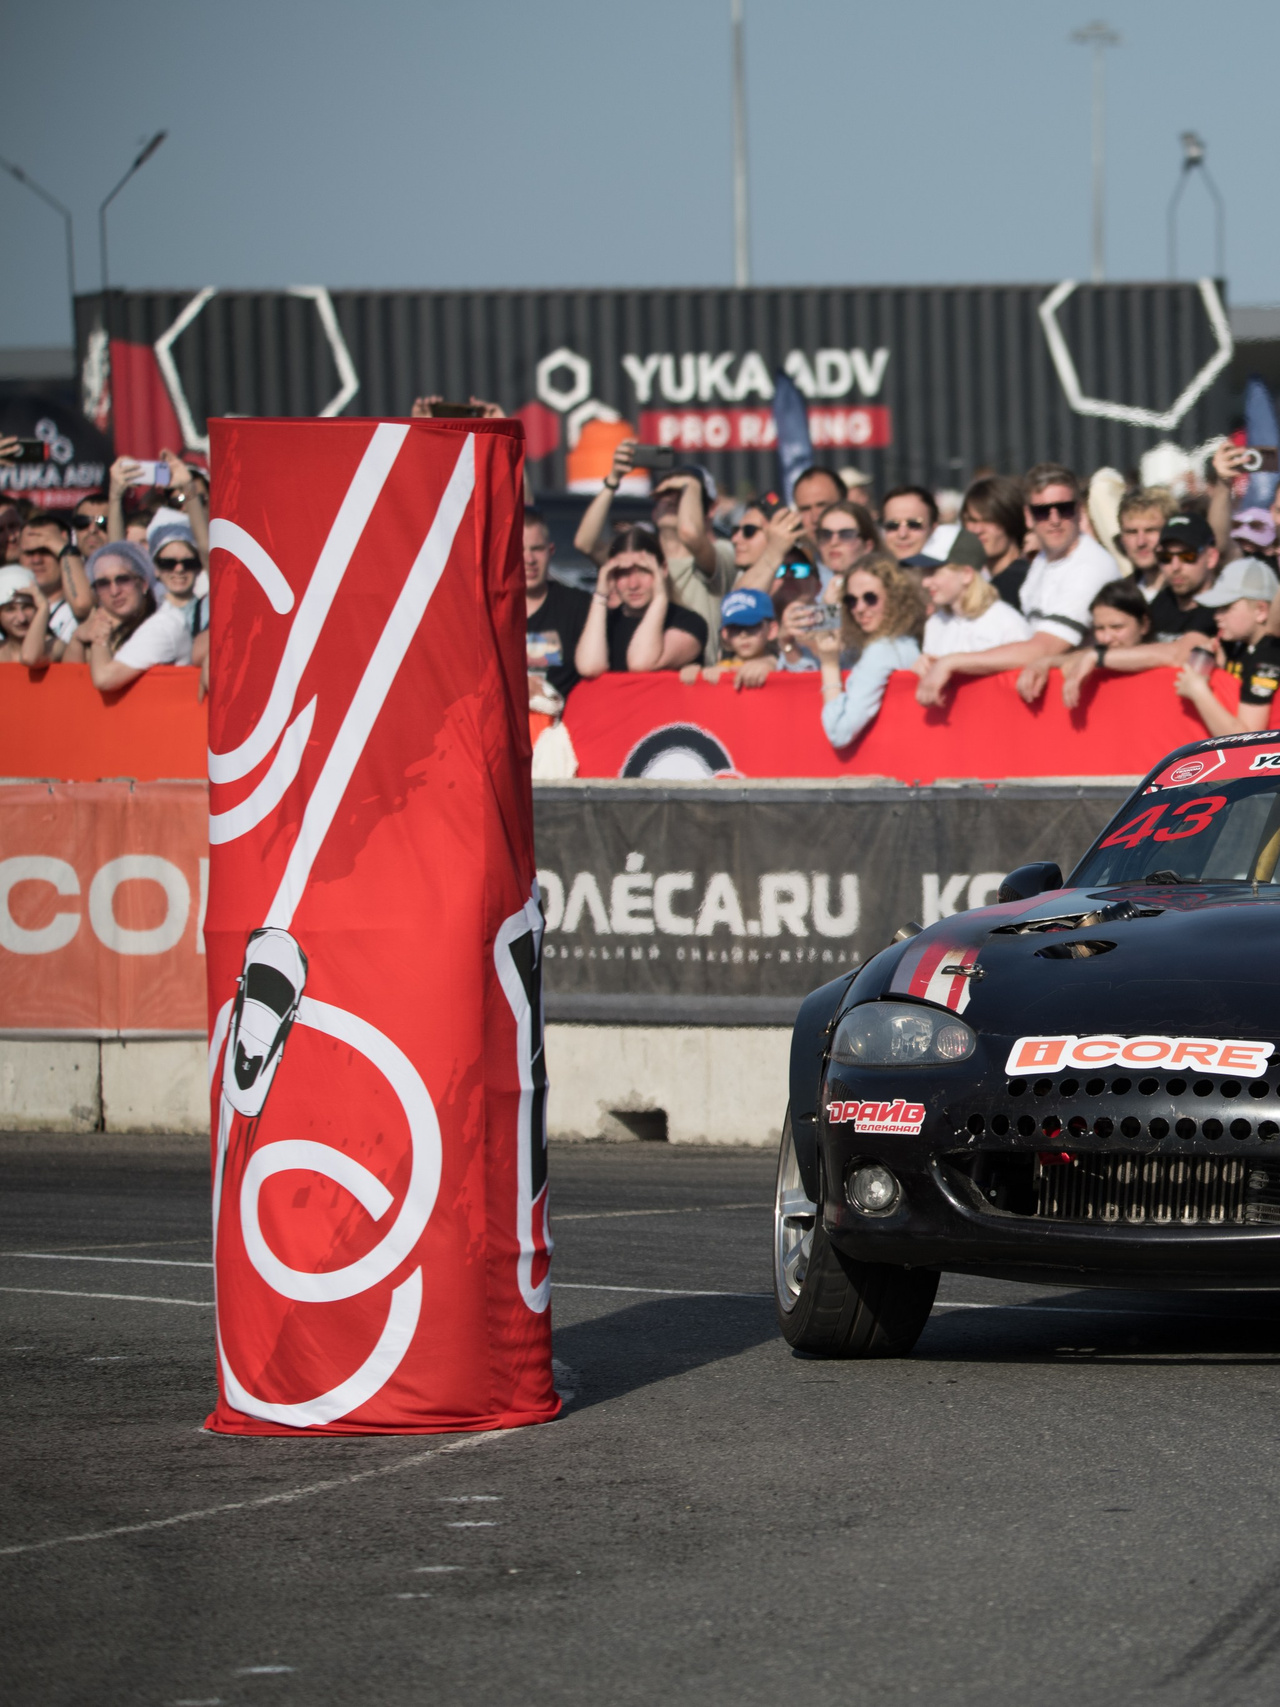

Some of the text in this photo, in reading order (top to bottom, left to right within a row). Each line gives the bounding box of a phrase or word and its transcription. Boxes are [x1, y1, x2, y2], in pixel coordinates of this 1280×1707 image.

[622, 347, 890, 403] YUKA ADV
[657, 410, 872, 450] PRO RAING
[1099, 795, 1228, 850] 43
[0, 854, 209, 955] CO
